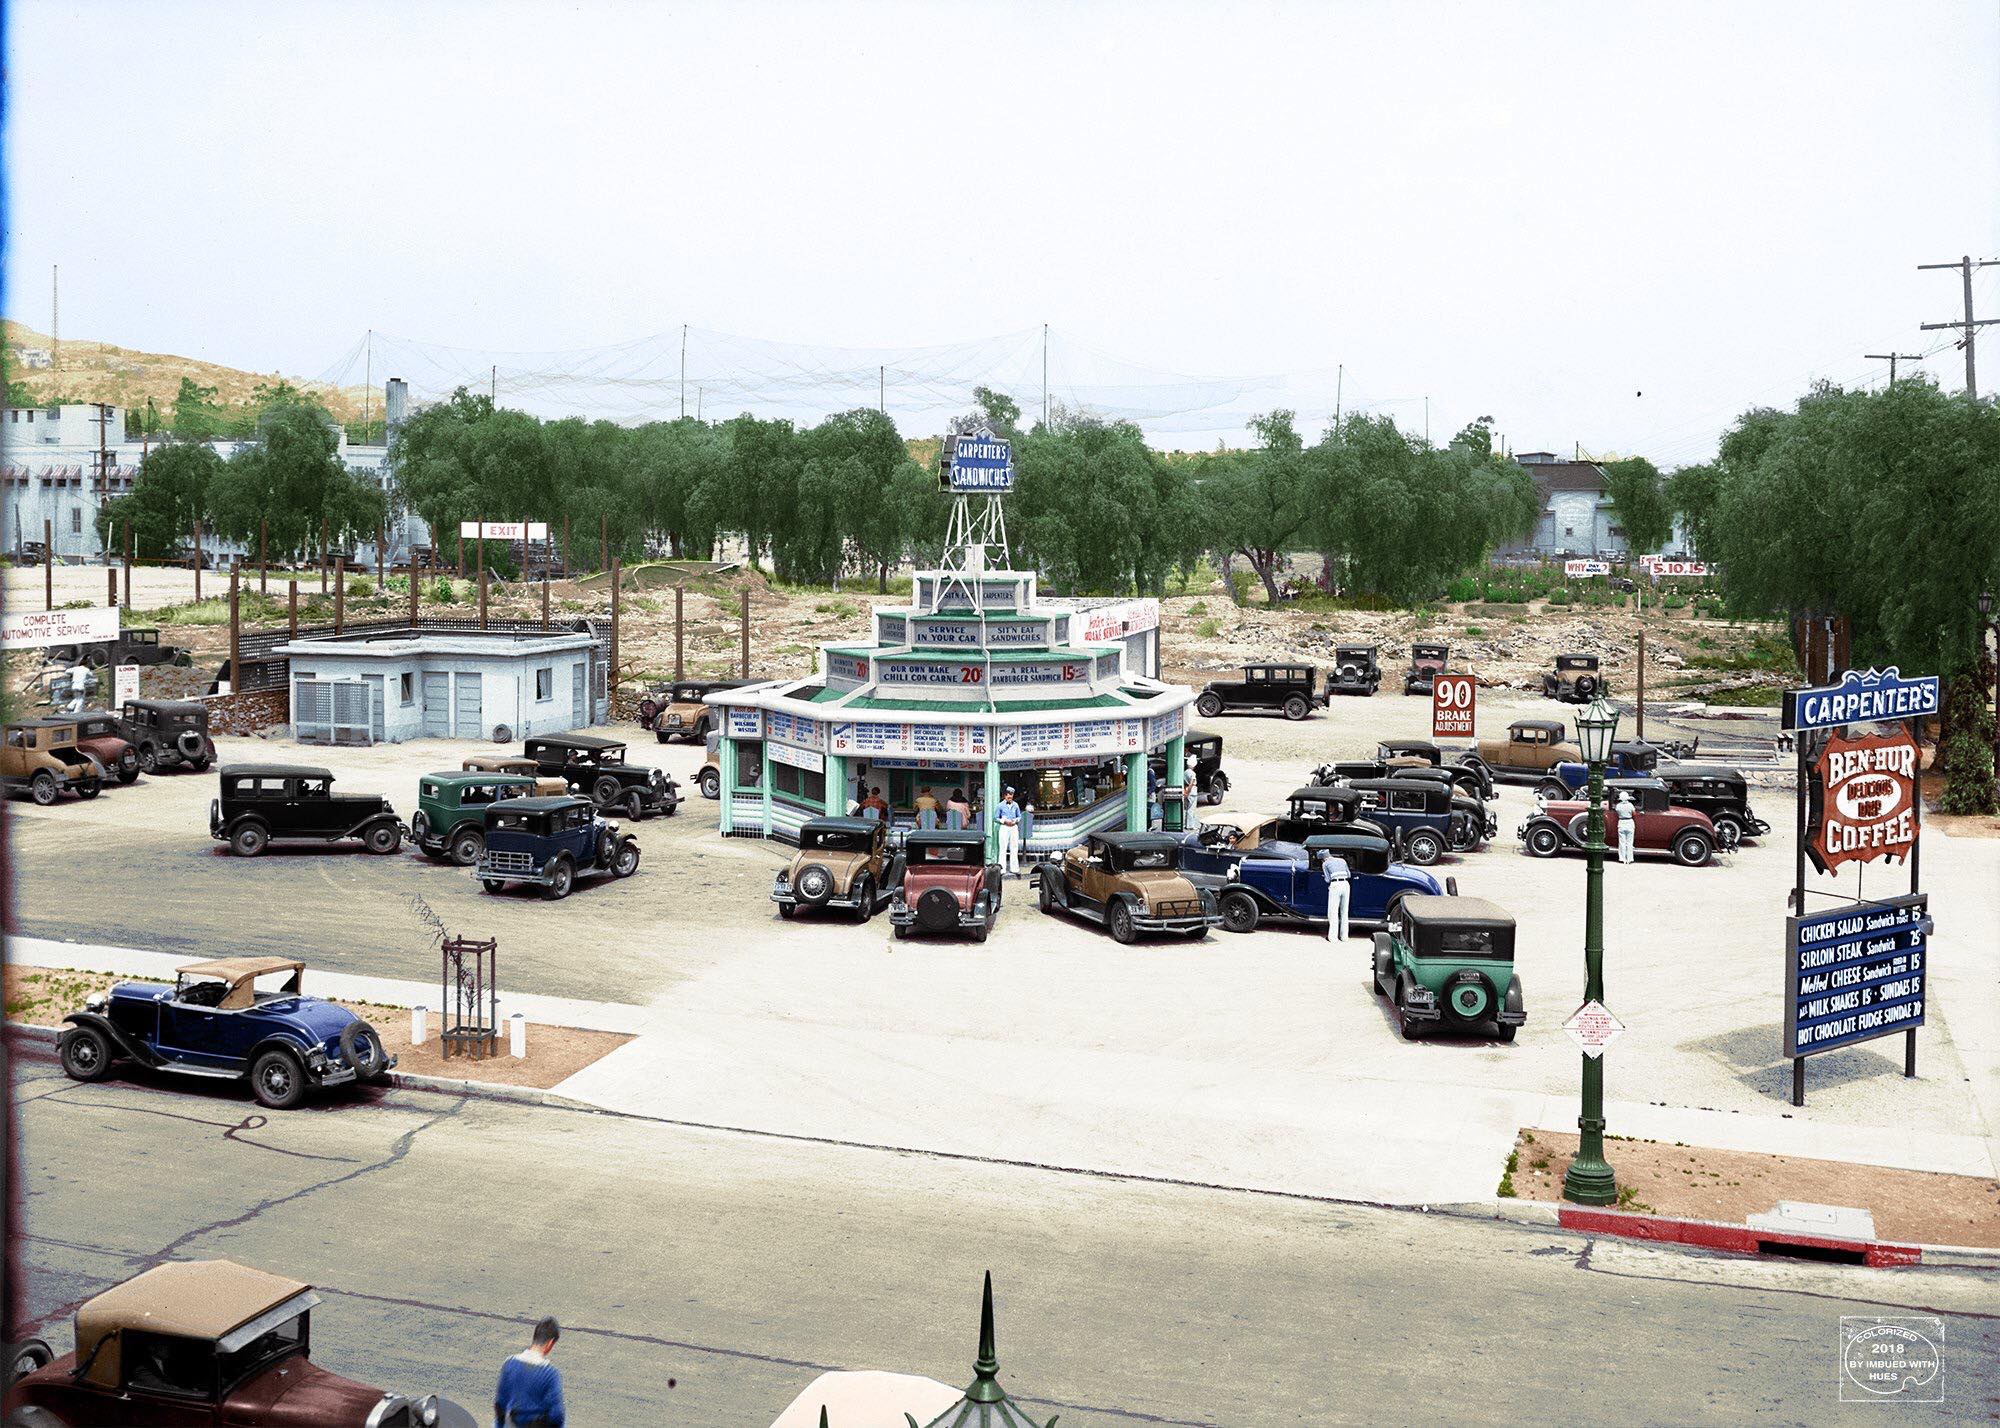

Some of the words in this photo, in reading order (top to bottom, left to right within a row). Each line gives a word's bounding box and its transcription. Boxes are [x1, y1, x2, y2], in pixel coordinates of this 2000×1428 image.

[958, 443, 1007, 460] CARPENTER'S
[953, 466, 1011, 486] SANDWICHES
[490, 526, 517, 536] EXIT
[1567, 563, 1586, 572] WHY
[23, 614, 66, 626] COMPLETE
[2, 627, 51, 640] AUTOMOTIVE
[57, 624, 90, 636] SERVICE
[929, 626, 966, 634] SERVICE
[931, 634, 955, 642] YOUR
[958, 634, 976, 643] CAR
[991, 634, 1041, 642] SANDWICHES
[891, 665, 907, 673] OUR
[929, 666, 950, 674] MAKE
[884, 674, 908, 682] CHILI
[912, 674, 927, 682] CON
[930, 674, 958, 683] CARNE
[993, 674, 1029, 683] HAMBURGER
[1031, 674, 1061, 682] SANDWICH
[1805, 683, 1936, 724] CARPENTER'S
[1437, 711, 1472, 721] BRAKE
[1435, 721, 1473, 731] ADJUSTMENT
[973, 745, 987, 754] PIES
[1828, 745, 1915, 789] BEN-HUR
[1847, 779, 1894, 801] DELICIOUS
[1826, 807, 1913, 854] COFFEE
[1801, 924, 1836, 944] CHICKEN
[1838, 917, 1864, 937] SALAD
[1867, 915, 1895, 930] Sandwich
[1801, 948, 1835, 970] SIRLOIN
[1837, 942, 1863, 962] STEAK
[1867, 939, 1896, 956] Sandwich
[1801, 973, 1829, 995] Melted
[1831, 966, 1862, 989] CHEESE
[1863, 964, 1892, 981] Sandwich
[1809, 998, 1830, 1018] MILK
[1830, 991, 1859, 1013] SHAKES
[1880, 980, 1910, 1001] SUNDAES
[1798, 1026, 1814, 1045] HOT
[1815, 1016, 1857, 1041] CHOCOLATE
[1859, 1011, 1883, 1031] FUDGE
[1884, 1004, 1912, 1024] SUNDAE
